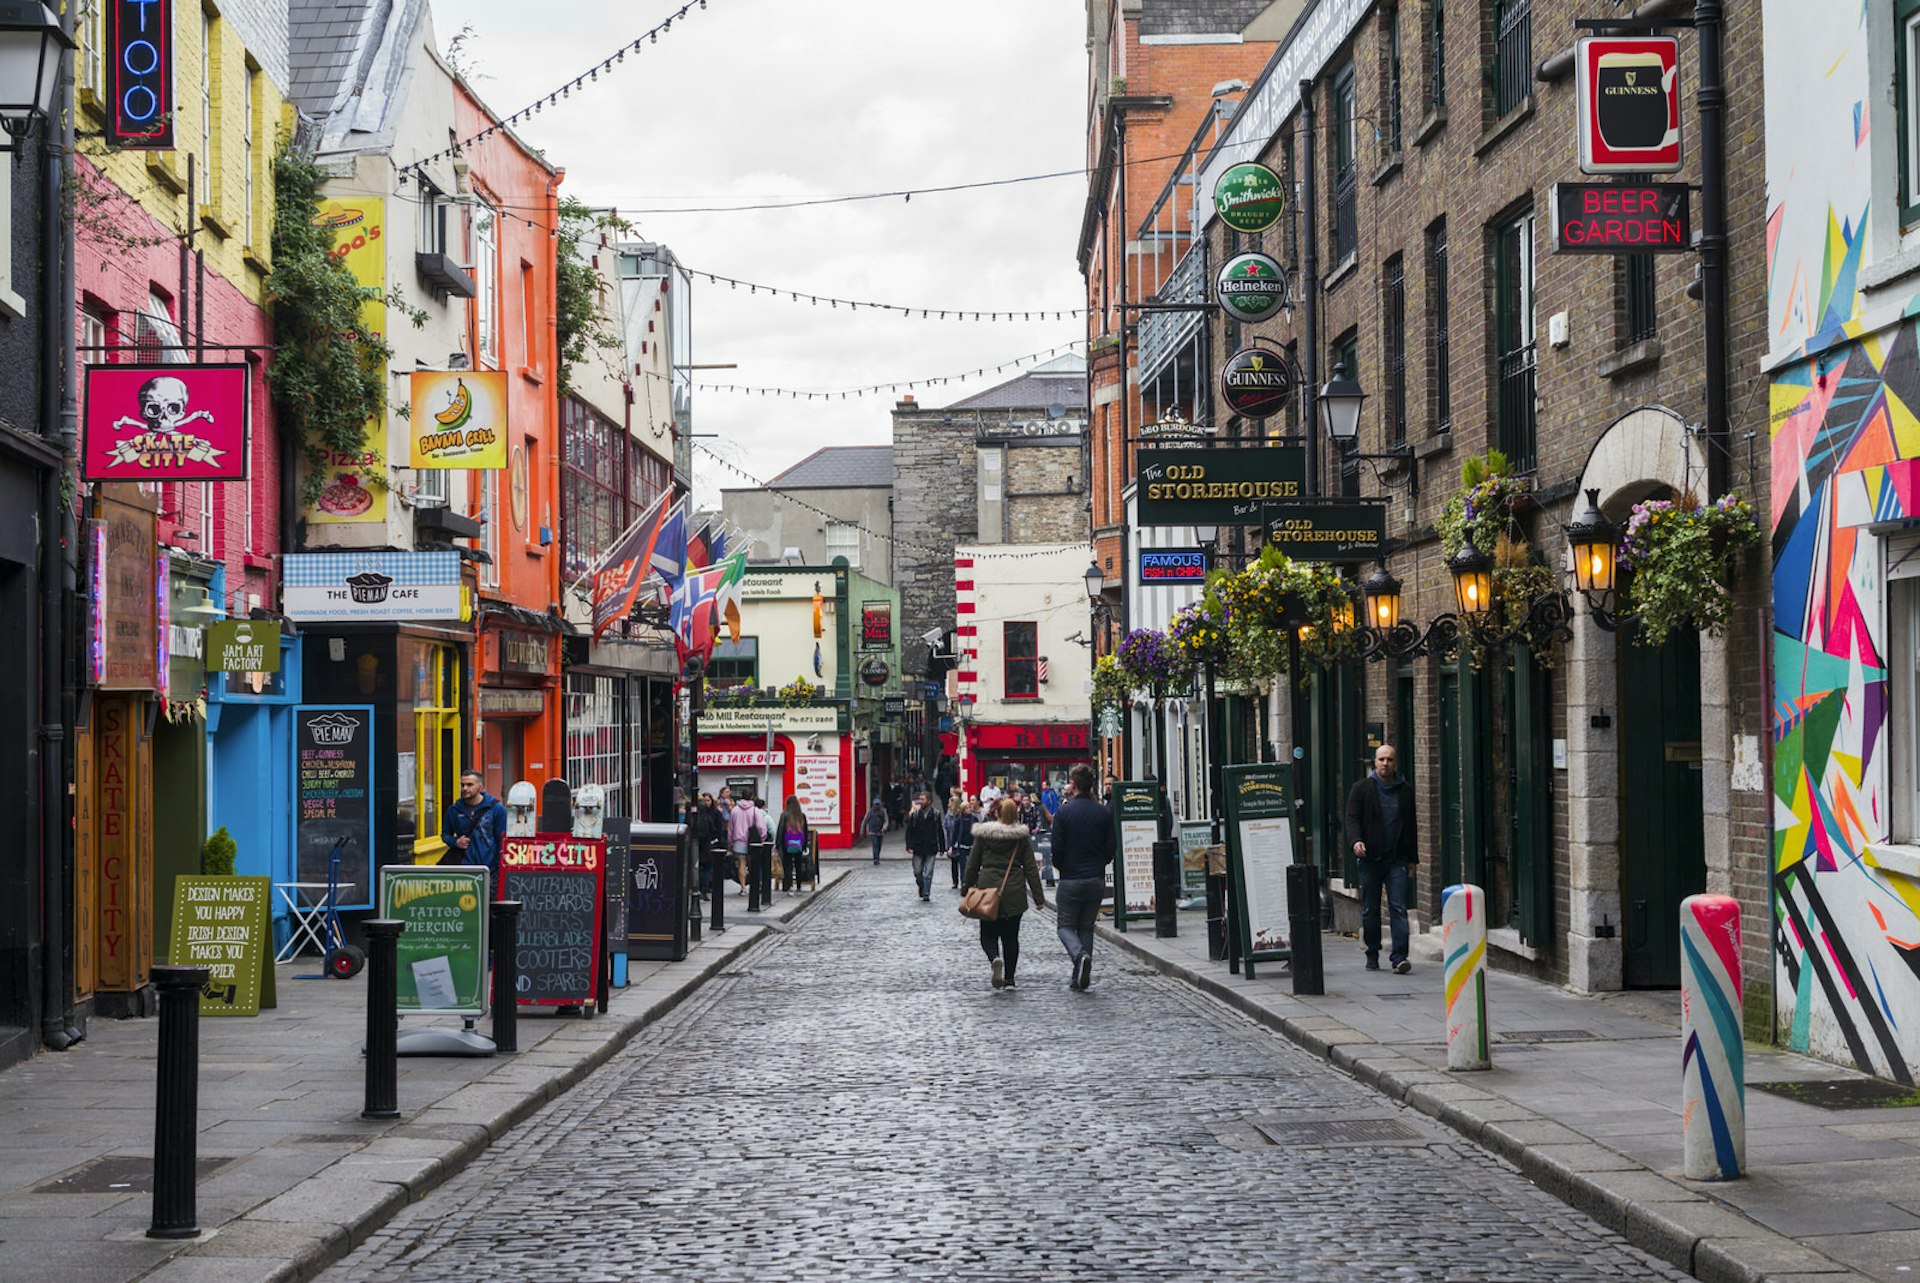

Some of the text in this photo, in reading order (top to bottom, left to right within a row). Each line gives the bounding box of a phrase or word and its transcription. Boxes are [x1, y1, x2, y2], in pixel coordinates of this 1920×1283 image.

[1604, 86, 1658, 96] GUINNESS
[1220, 187, 1282, 212] Smithwick's
[1583, 191, 1660, 214] BEER
[1564, 219, 1682, 244] GARDEN
[1222, 280, 1282, 293] Heineken
[1227, 371, 1287, 386] GUINNESS
[1140, 424, 1159, 436] LEO
[132, 434, 196, 452] SKATE
[418, 427, 497, 455] BANANA GRILL
[138, 451, 188, 469] CITY
[1142, 462, 1206, 482] The OLD
[1147, 481, 1299, 500] STOREHOUSE
[1233, 504, 1248, 516] Bar
[1269, 517, 1313, 531] The OLD
[1272, 530, 1377, 543] STOREHOUSE
[1144, 555, 1201, 566] FAMOUS
[1143, 567, 1165, 577] FISH
[1175, 566, 1203, 576] CHIPS
[327, 587, 419, 602] THE PIEMAN CAFE
[863, 616, 889, 627] OLD
[865, 628, 889, 639] MILL
[222, 644, 265, 658] JAM ART
[223, 657, 263, 671] FACTORY
[716, 711, 733, 721] Mill
[734, 711, 786, 721] Restaurant
[314, 726, 353, 742] PIE MAN
[697, 753, 778, 764] MPLE TAKE OUT
[1239, 783, 1283, 794] STOREHOUSE
[303, 798, 336, 809] VEGGIE PIE
[327, 808, 336, 819] PIE
[103, 708, 124, 958] SKATE CITY
[504, 842, 598, 871] SKATE CITY
[508, 875, 595, 895] SKATEBOARDS
[187, 887, 255, 901] DESIGN MAKES
[394, 879, 474, 909] CONNECTED INK
[194, 905, 246, 920] YOU HAPPY
[408, 906, 461, 921] TATTOO
[404, 919, 464, 935] PIERCING
[516, 911, 584, 930] RUISERS
[187, 926, 250, 941] IRISH DESIGN
[515, 930, 594, 947] OLLERBLADES
[190, 945, 244, 959] MAKES YOU
[515, 948, 593, 970] COOTERS
[515, 971, 590, 992] ND SPARES
